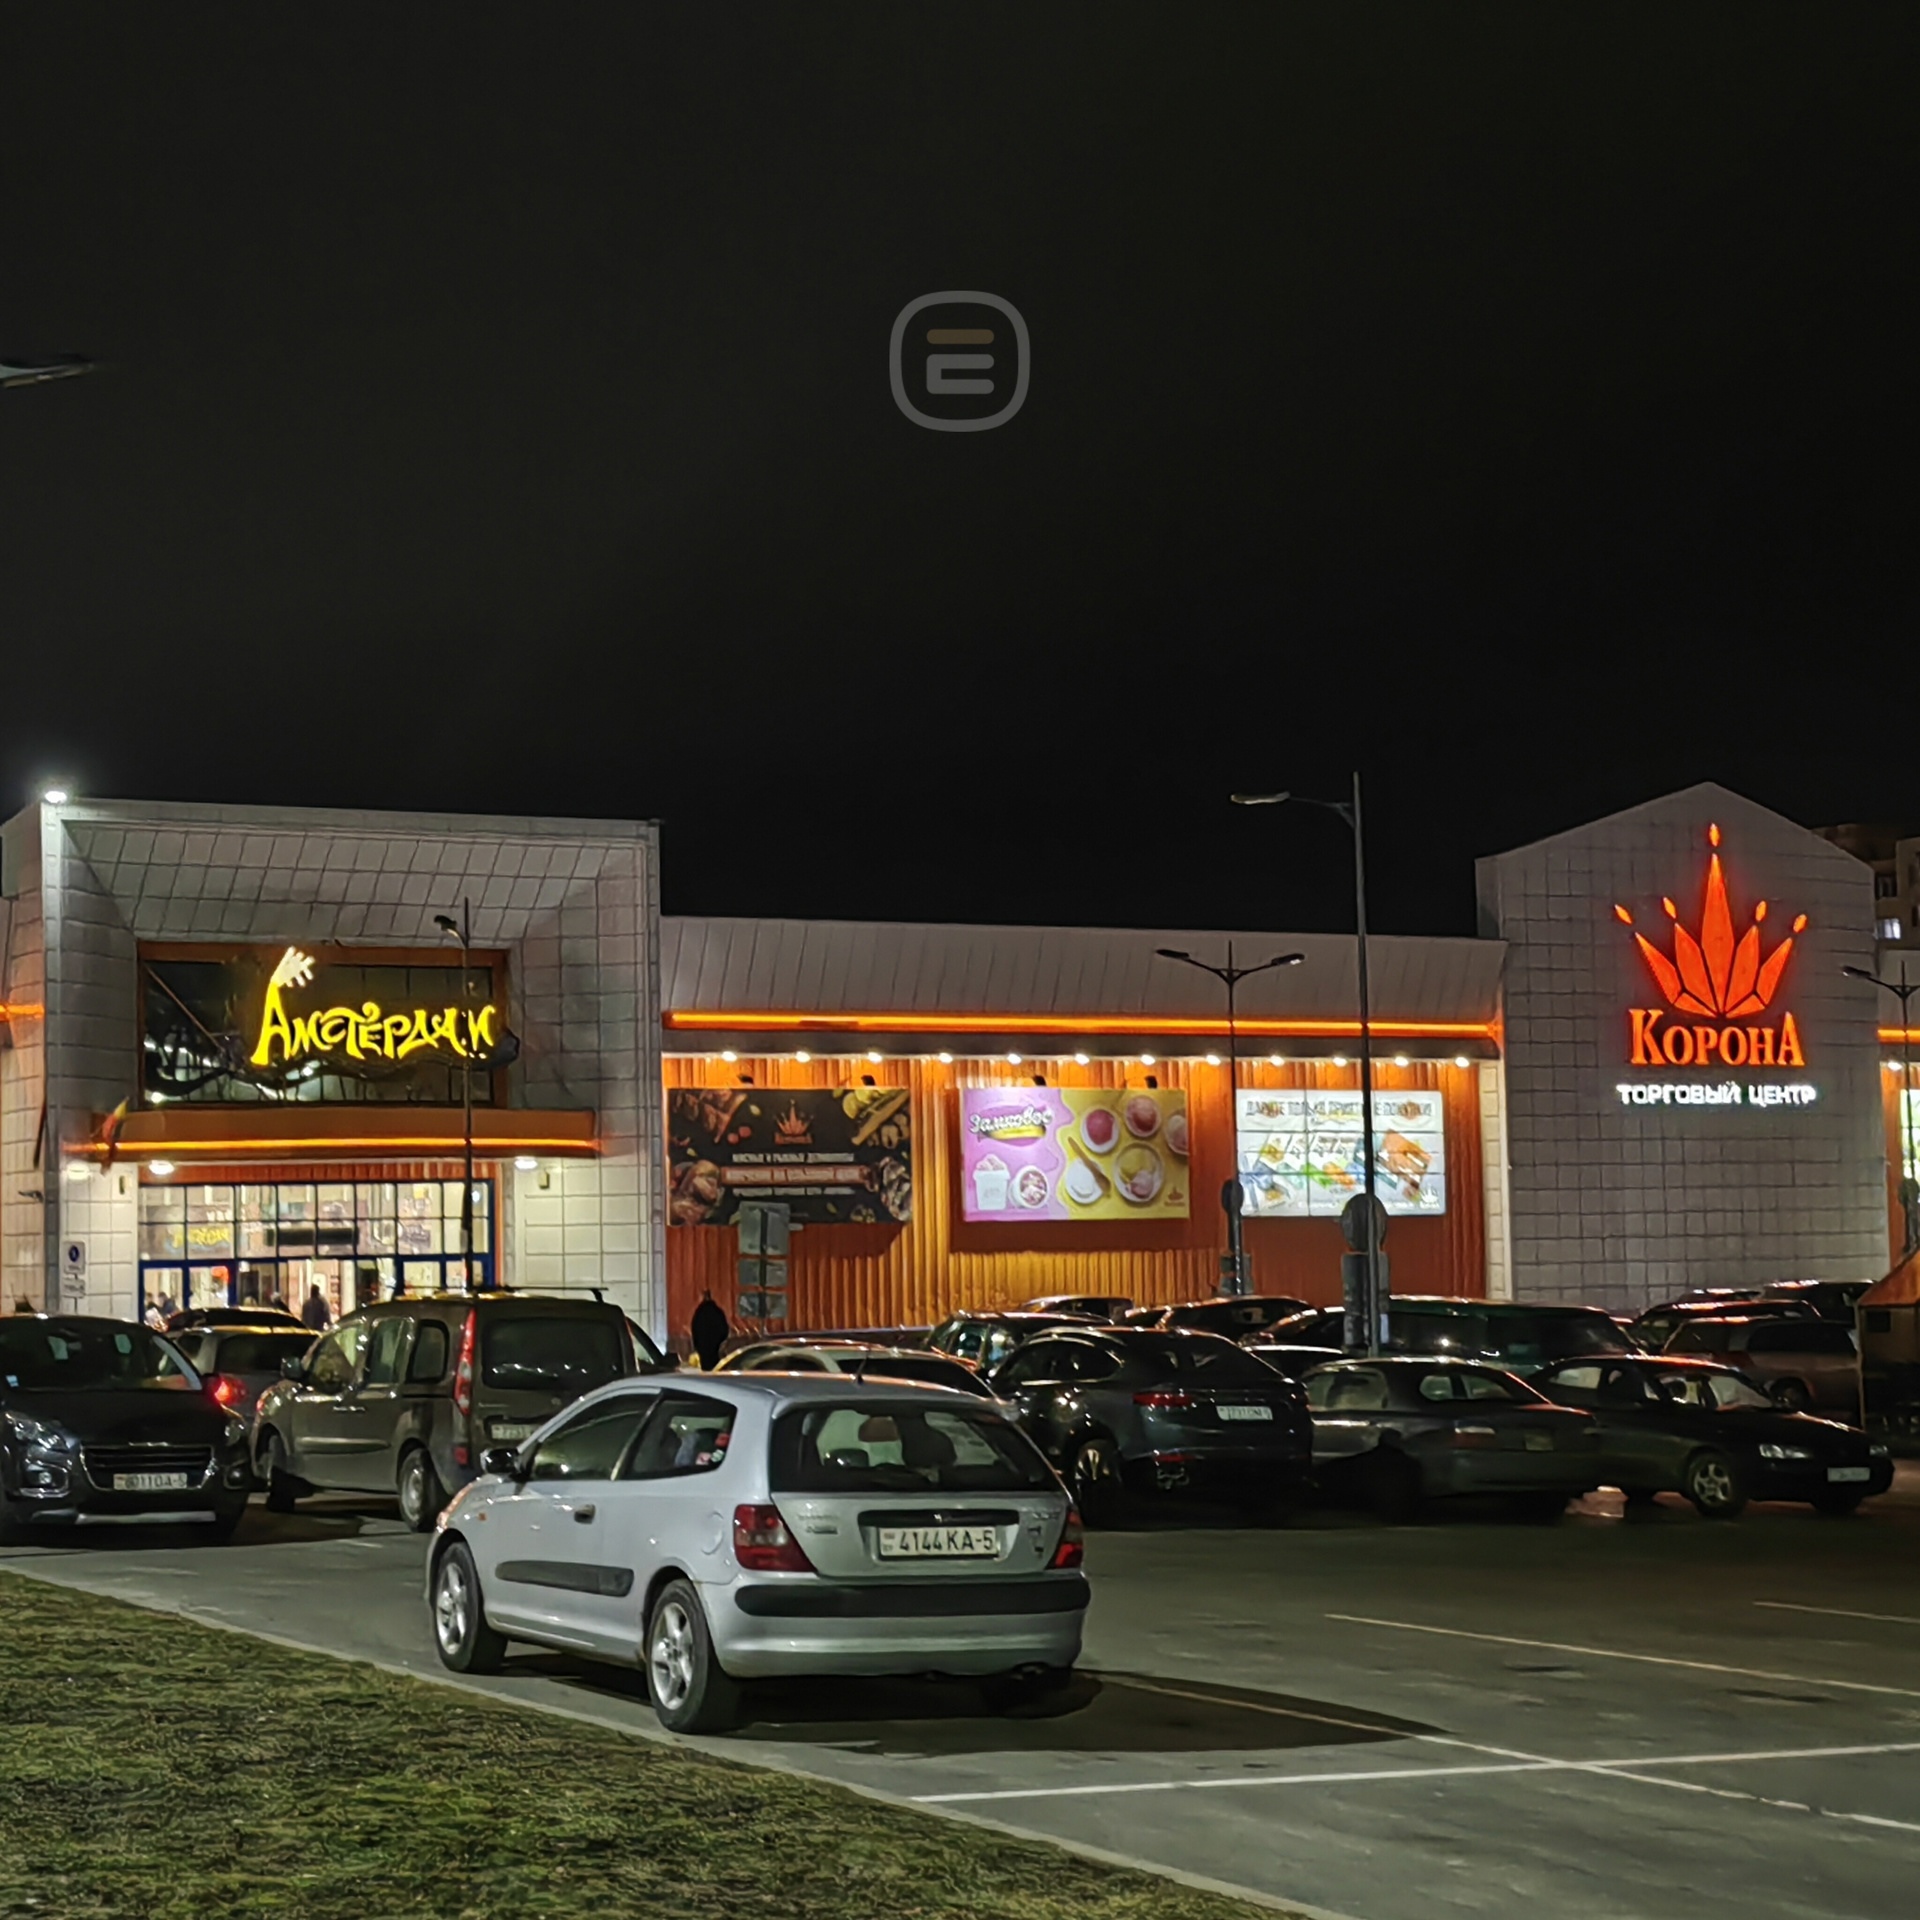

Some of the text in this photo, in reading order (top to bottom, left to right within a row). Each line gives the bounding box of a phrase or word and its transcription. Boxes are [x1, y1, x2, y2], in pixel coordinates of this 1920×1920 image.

[1628, 1008, 1806, 1067] КОРОНА
[1615, 1080, 1818, 1108] ТОРГОВЫЙ ЦЕНТР
